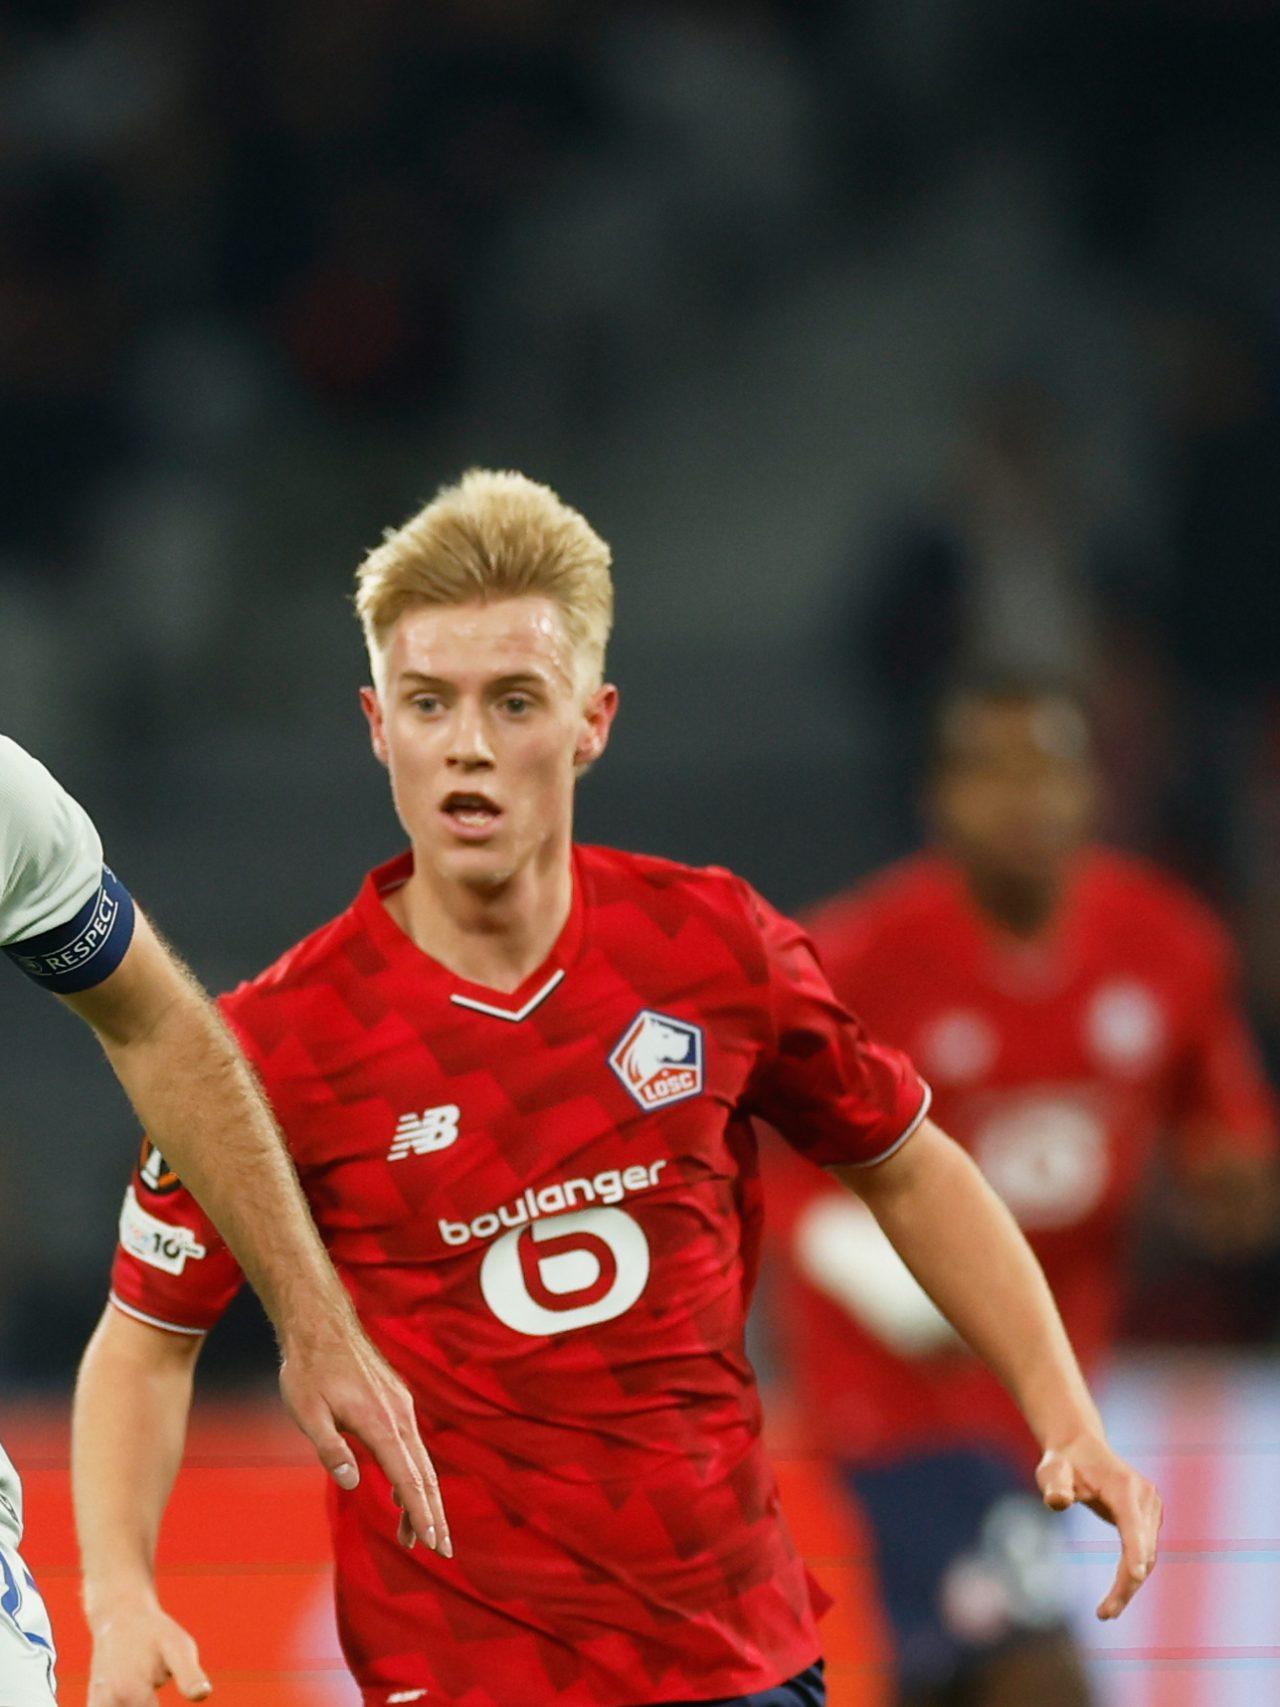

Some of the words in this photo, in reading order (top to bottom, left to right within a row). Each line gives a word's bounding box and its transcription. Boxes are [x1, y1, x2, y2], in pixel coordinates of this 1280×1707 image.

[46, 889, 114, 970] RESPECT
[642, 1071, 695, 1103] LOSC
[437, 1159, 667, 1246] boulanger
